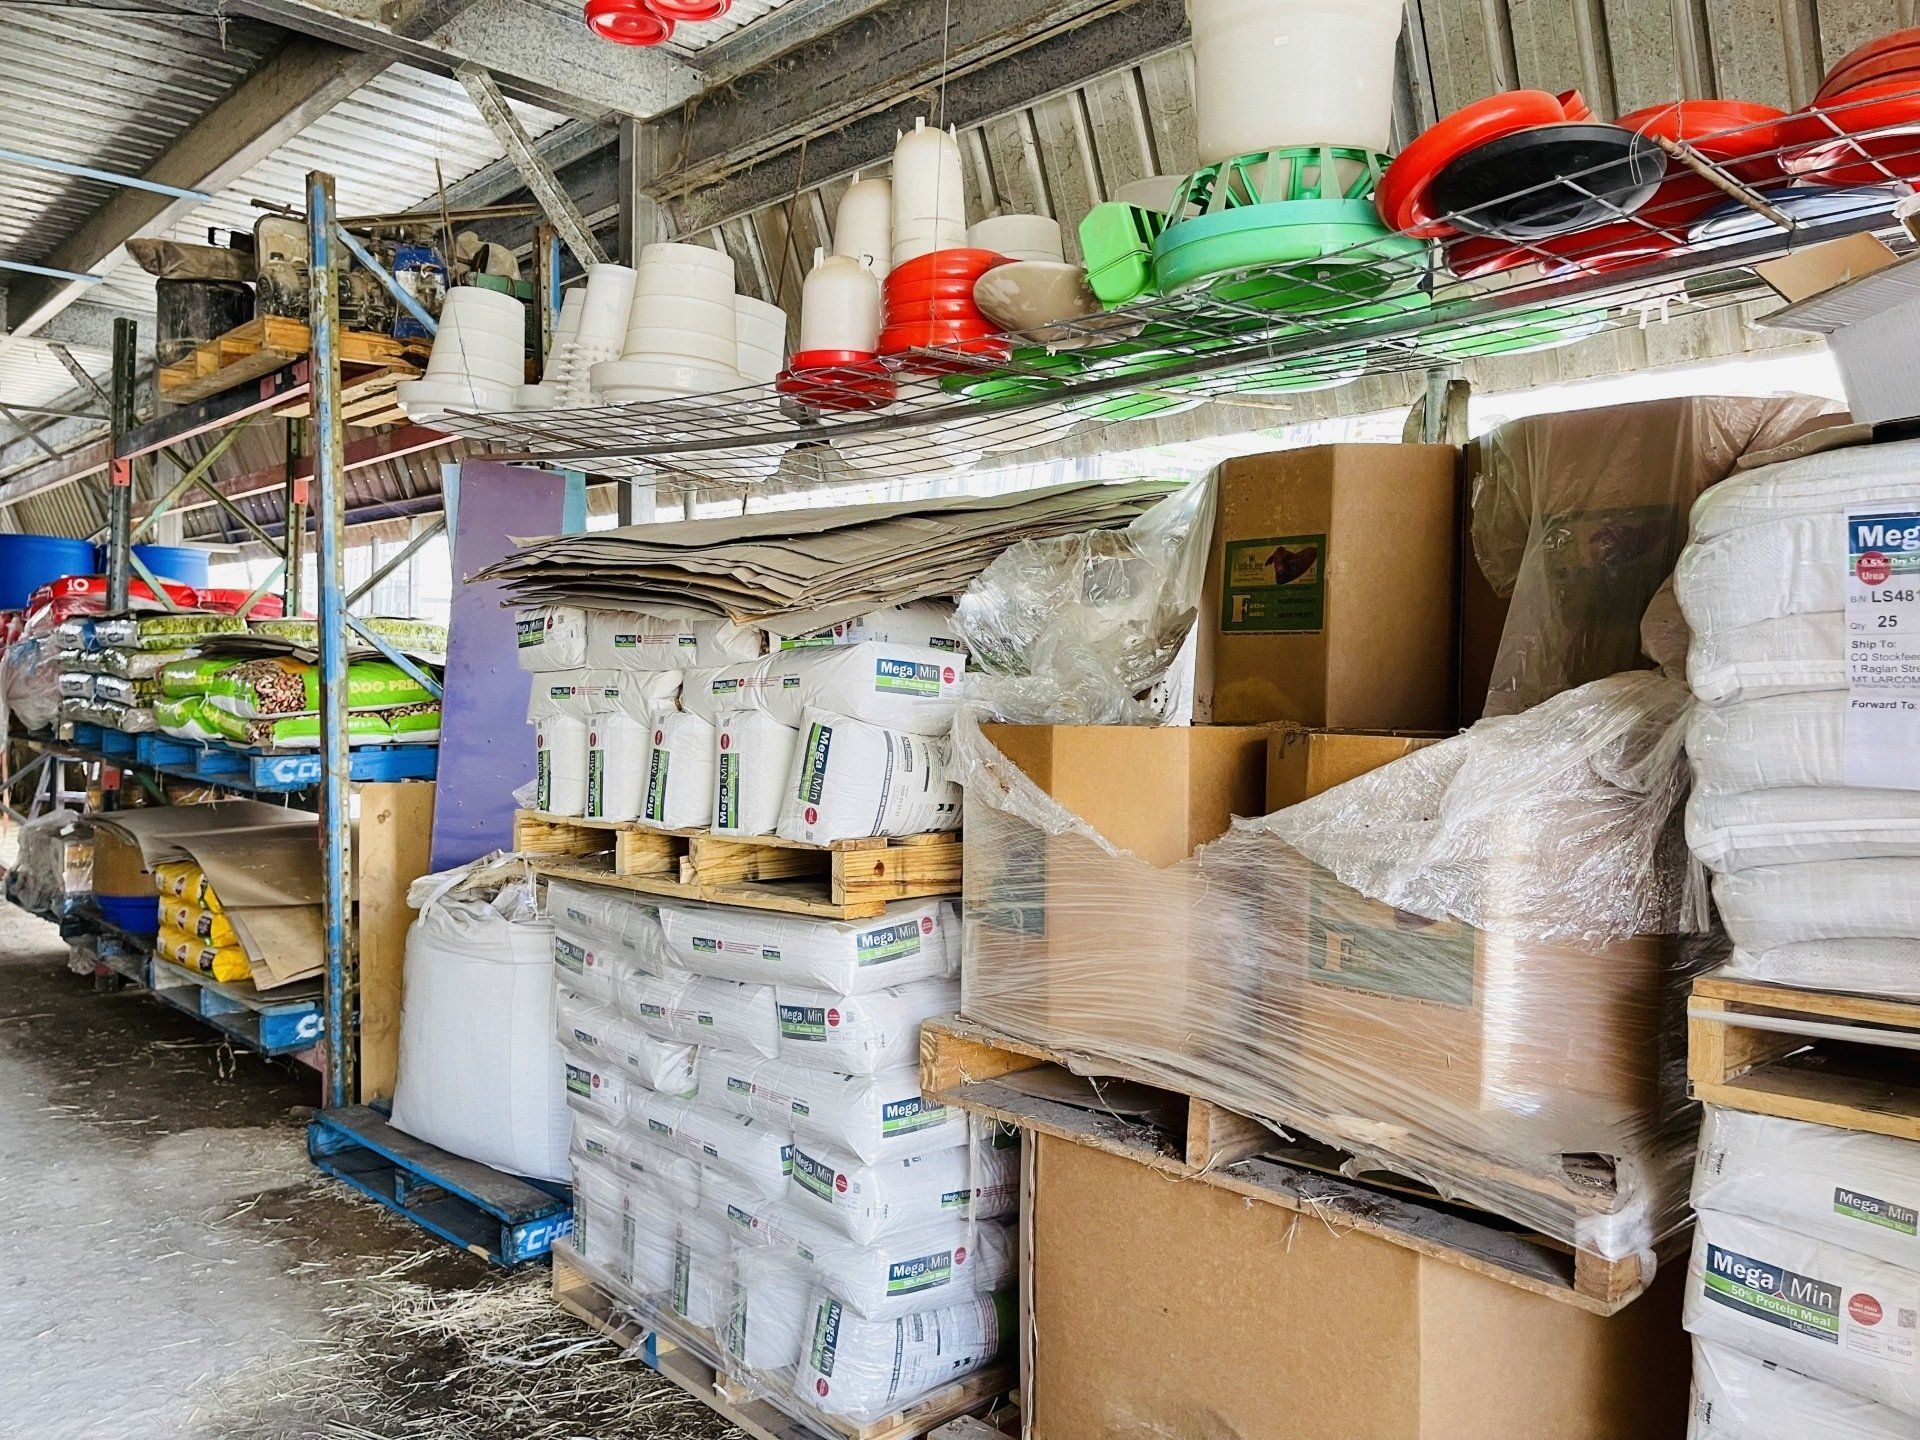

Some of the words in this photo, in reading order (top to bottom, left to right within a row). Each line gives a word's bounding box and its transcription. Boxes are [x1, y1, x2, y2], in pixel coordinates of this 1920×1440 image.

[67, 578, 89, 592] 10
[1861, 571, 1885, 580] Urea
[1878, 615, 1898, 628] 25
[1851, 640, 1876, 650] Ship
[1881, 640, 1896, 648] To:
[1851, 653, 1868, 661] CQ
[881, 661, 913, 678] Mega
[920, 666, 938, 679] Min
[1861, 664, 1898, 674] Raglan
[350, 680, 386, 694] DOG
[1851, 700, 1897, 710] Forward
[1902, 701, 1917, 710] To:
[814, 731, 830, 769] Mega
[810, 777, 821, 800] Min
[646, 782, 657, 815] Mega
[720, 787, 728, 823] Mega
[861, 932, 894, 947] Mega
[900, 925, 917, 939] Min
[781, 1007, 803, 1023] Mega
[807, 1010, 823, 1023] Min
[887, 1103, 919, 1118] Mega
[795, 1151, 813, 1173] Mega
[817, 1165, 832, 1182] Min
[1840, 1191, 1879, 1212] Mega
[1888, 1205, 1914, 1223] Min
[893, 1262, 924, 1277] Mega
[931, 1256, 949, 1269] Min
[1713, 1250, 1774, 1290] Mega
[1790, 1277, 1833, 1309] Min
[1731, 1284, 1753, 1301] 50%
[1756, 1294, 1798, 1316] Protein
[1800, 1309, 1832, 1327] Meal
[825, 1305, 840, 1343] Mega
